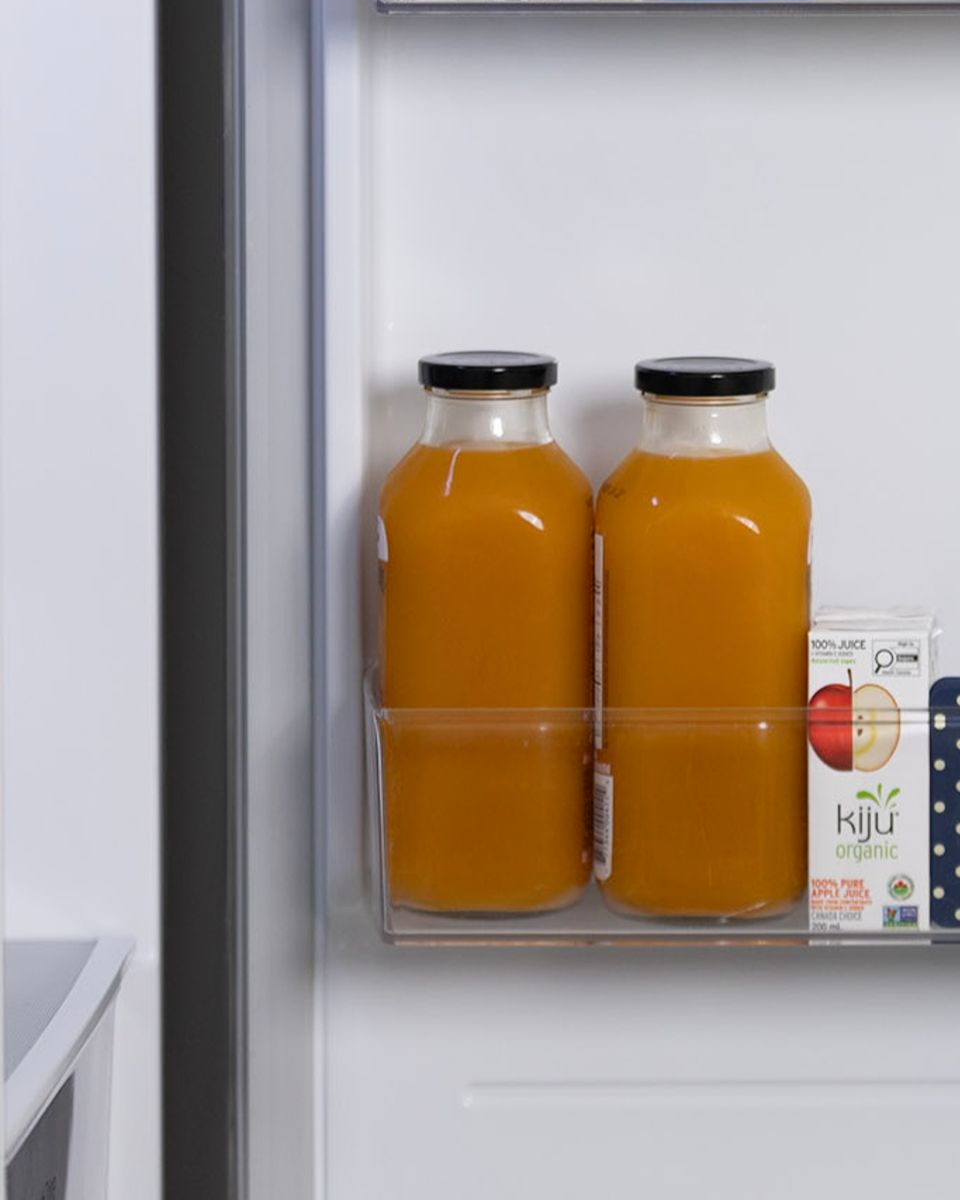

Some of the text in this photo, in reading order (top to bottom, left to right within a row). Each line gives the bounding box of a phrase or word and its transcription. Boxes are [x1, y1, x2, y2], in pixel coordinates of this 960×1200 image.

[811, 640, 866, 650] 100% JUICE
[837, 804, 894, 843] kiju
[836, 841, 898, 863] organic
[811, 879, 864, 888] 100% PURE
[811, 888, 870, 898] APPLE JUICE
